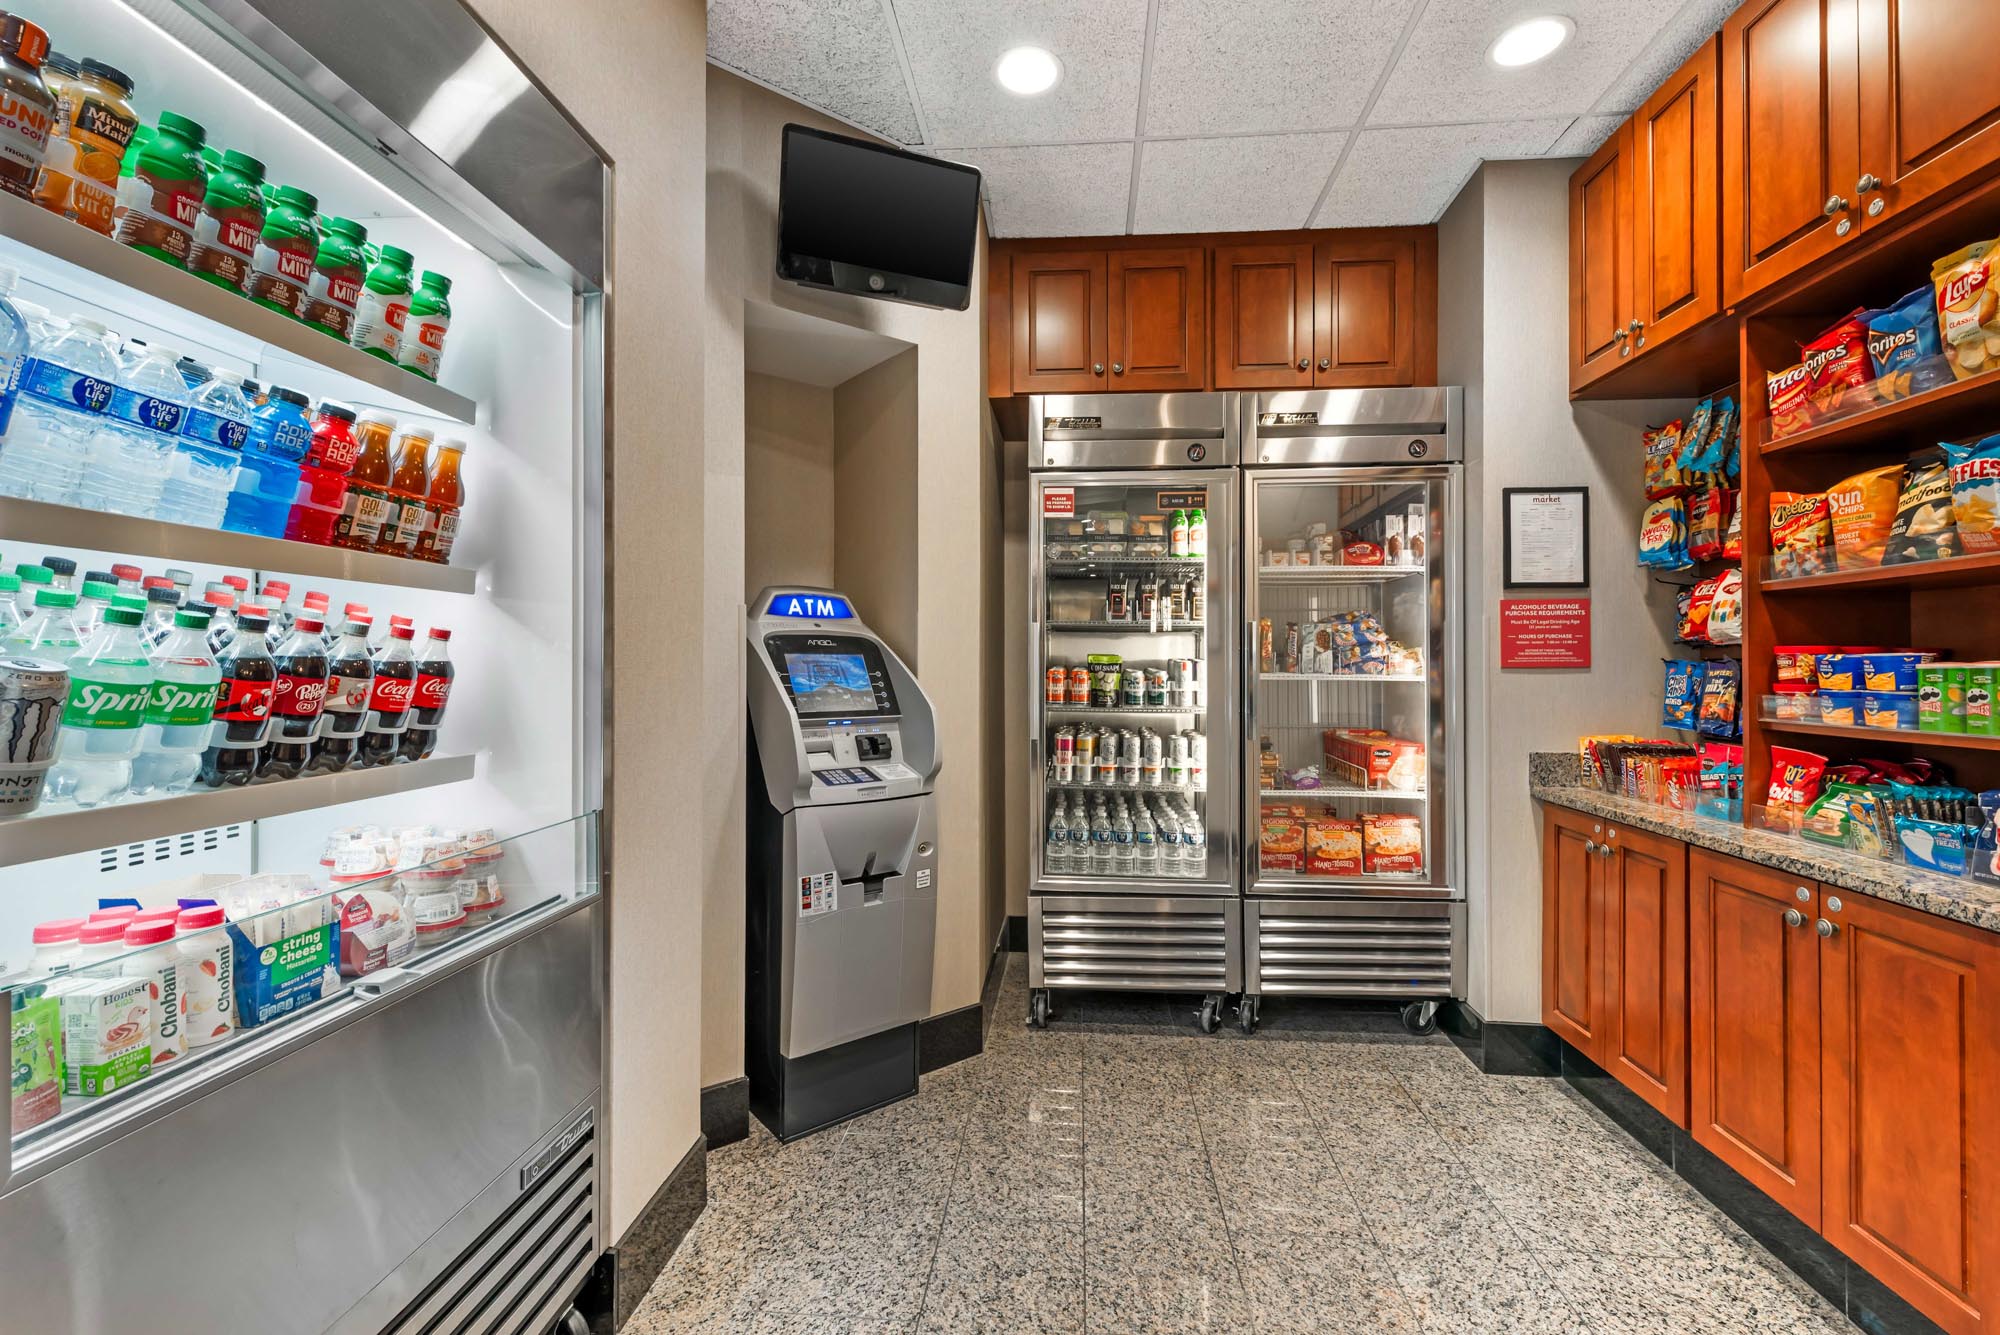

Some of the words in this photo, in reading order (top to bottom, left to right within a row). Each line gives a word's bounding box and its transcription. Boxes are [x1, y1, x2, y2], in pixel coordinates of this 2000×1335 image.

[88, 106, 134, 136] Minut
[93, 120, 130, 143] Maid
[80, 194, 101, 215] VIT
[101, 207, 110, 220] C
[1949, 314, 1977, 329] CLASSIC
[1805, 344, 1847, 371] oritos
[85, 377, 111, 394] Pure
[1768, 366, 1806, 402] Frito
[86, 388, 105, 401] Life
[149, 399, 178, 415] Pure
[150, 408, 172, 422] Life
[227, 421, 247, 434] Pure
[227, 430, 244, 443] Life
[274, 432, 305, 449] ADE
[326, 448, 354, 464] ADE
[1949, 460, 2000, 489] UFFLES
[1533, 493, 1560, 503] market
[1829, 489, 1861, 514] Sun
[1772, 497, 1817, 528] Cheetos
[1839, 503, 1865, 516] CHIPS
[788, 598, 834, 616] ATM
[8, 673, 42, 682] ZERO
[311, 683, 323, 692] Dr
[1700, 773, 1725, 781] BEAST
[1784, 766, 1808, 782] RITZ
[1769, 783, 1805, 803] bits
[282, 931, 321, 953] string
[279, 942, 323, 965] cheese
[217, 945, 230, 1013] Chobani
[103, 981, 149, 1006] Honest
[160, 966, 178, 1039] Chobani
[107, 1041, 147, 1060] ORGANIC
